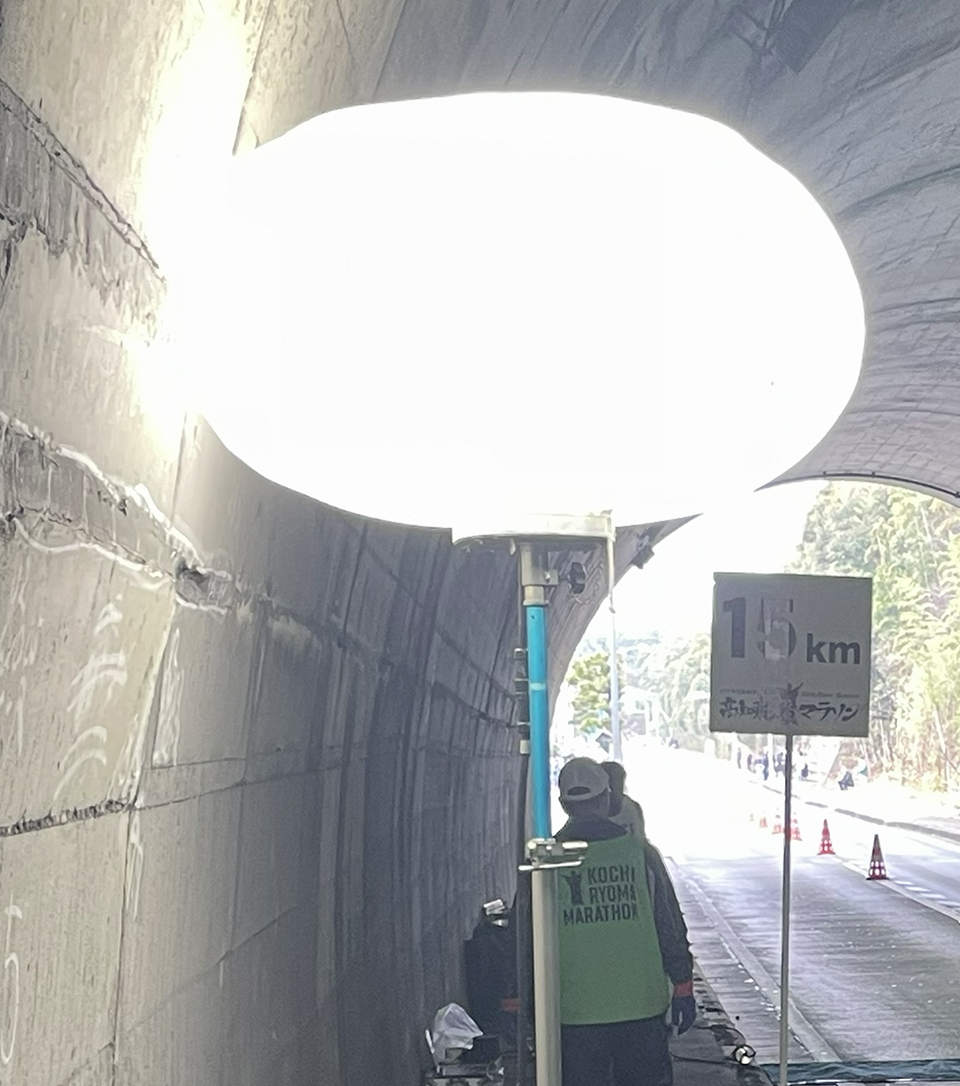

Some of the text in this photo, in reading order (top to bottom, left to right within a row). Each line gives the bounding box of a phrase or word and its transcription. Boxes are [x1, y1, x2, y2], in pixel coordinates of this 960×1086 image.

[722, 597, 861, 665] 15 km
[587, 865, 635, 884] KOCHI
[589, 884, 637, 905] RYOMA
